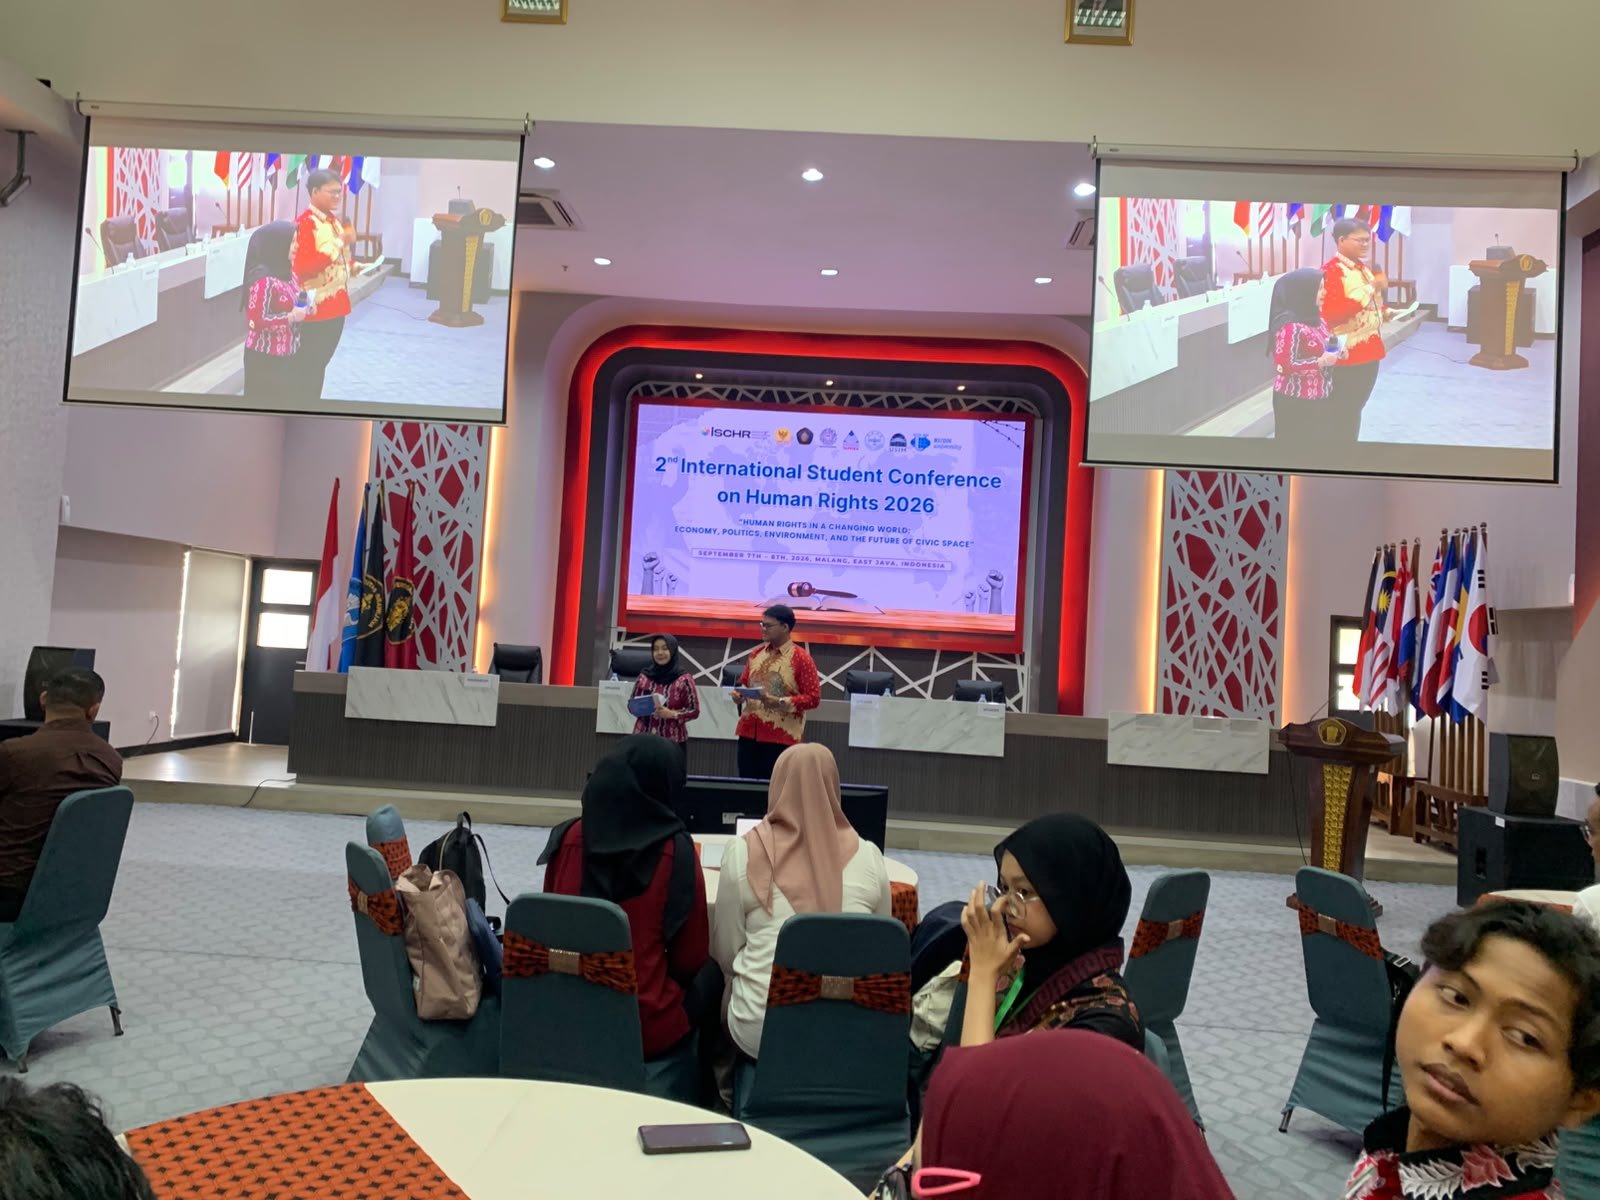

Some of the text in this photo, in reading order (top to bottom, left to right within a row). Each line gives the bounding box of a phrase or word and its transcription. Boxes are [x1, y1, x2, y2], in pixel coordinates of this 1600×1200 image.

[655, 456, 1002, 489] 2nd International Student Conference
[717, 489, 935, 513] on Human Rights 2026
[674, 525, 720, 535] ECONOMY,
[722, 528, 762, 537] POLITICS,
[764, 530, 828, 541] ENVIRONMENT,
[830, 534, 849, 542] AND
[851, 535, 866, 543] THE
[868, 536, 900, 545] FUTURE
[915, 538, 939, 546] CIVIC
[777, 520, 808, 529] RIGHTS
[820, 522, 826, 530] A
[828, 523, 875, 532] CHANGING
[698, 550, 744, 558] SEPTEMBER
[815, 556, 850, 564] MALANG,
[901, 561, 946, 569] INDONESIA
